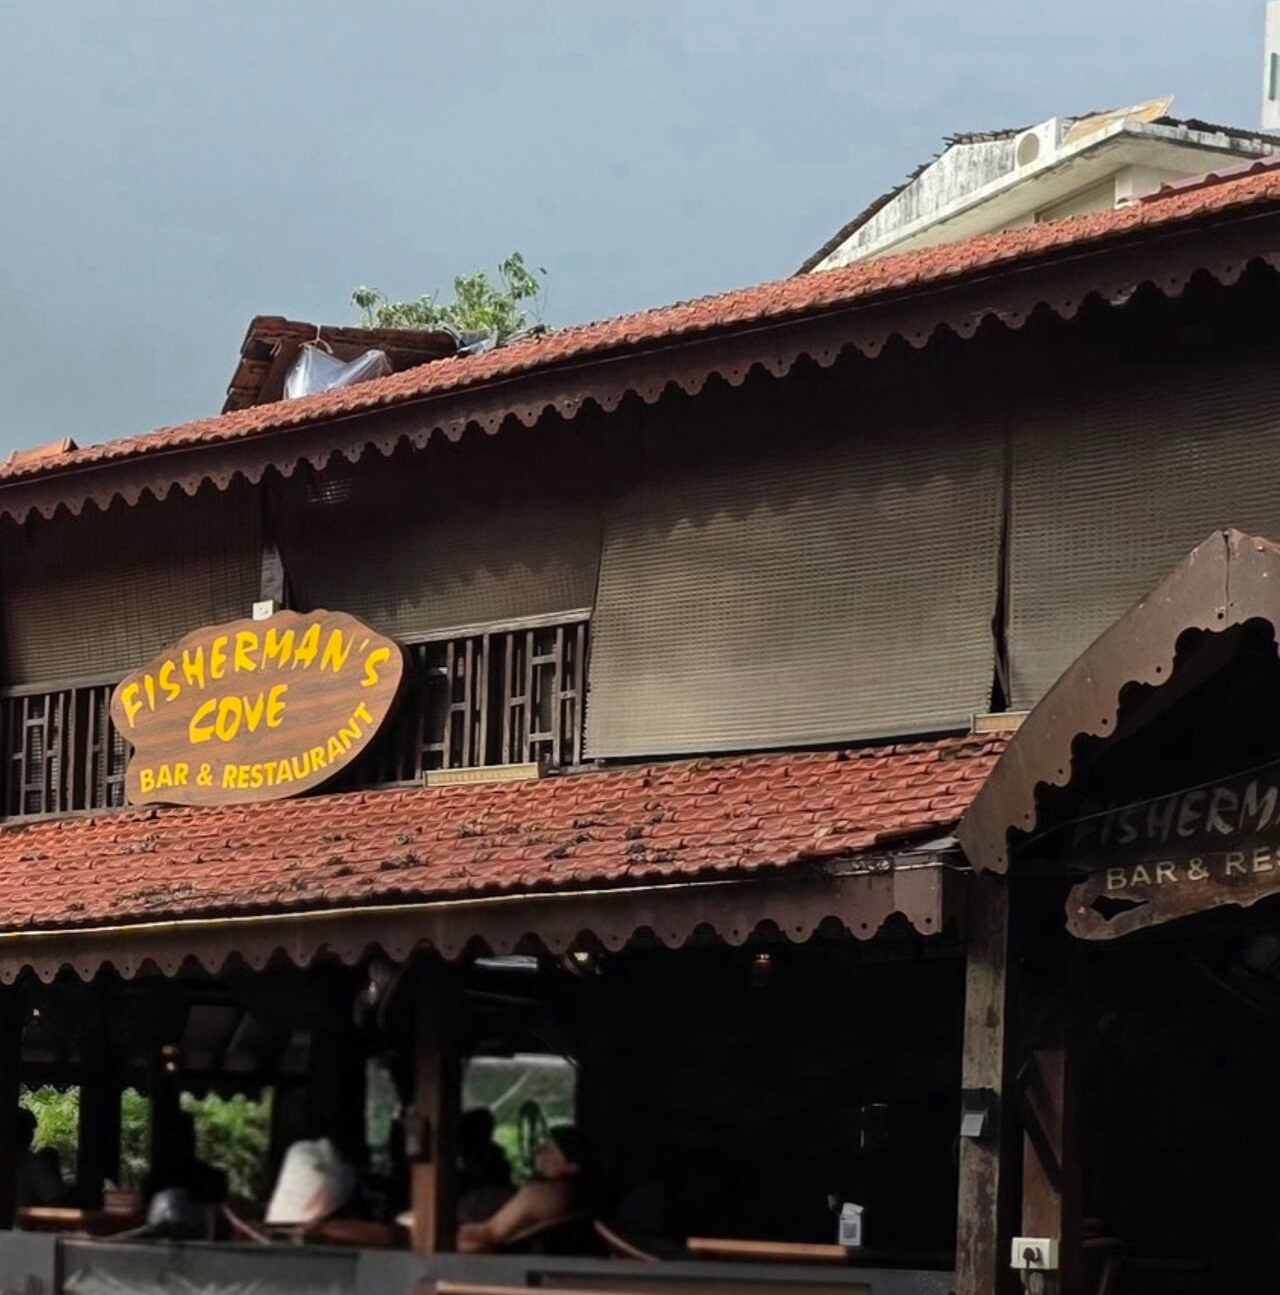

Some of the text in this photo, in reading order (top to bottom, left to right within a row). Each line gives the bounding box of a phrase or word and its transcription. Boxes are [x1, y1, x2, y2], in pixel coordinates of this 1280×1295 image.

[121, 623, 390, 728] FISHERMAN'S
[140, 702, 374, 793] BAR & RESTAURANT
[189, 684, 288, 744] COVE
[1072, 779, 1280, 848] FISHERM
[1106, 847, 1280, 890] BAR & RE
